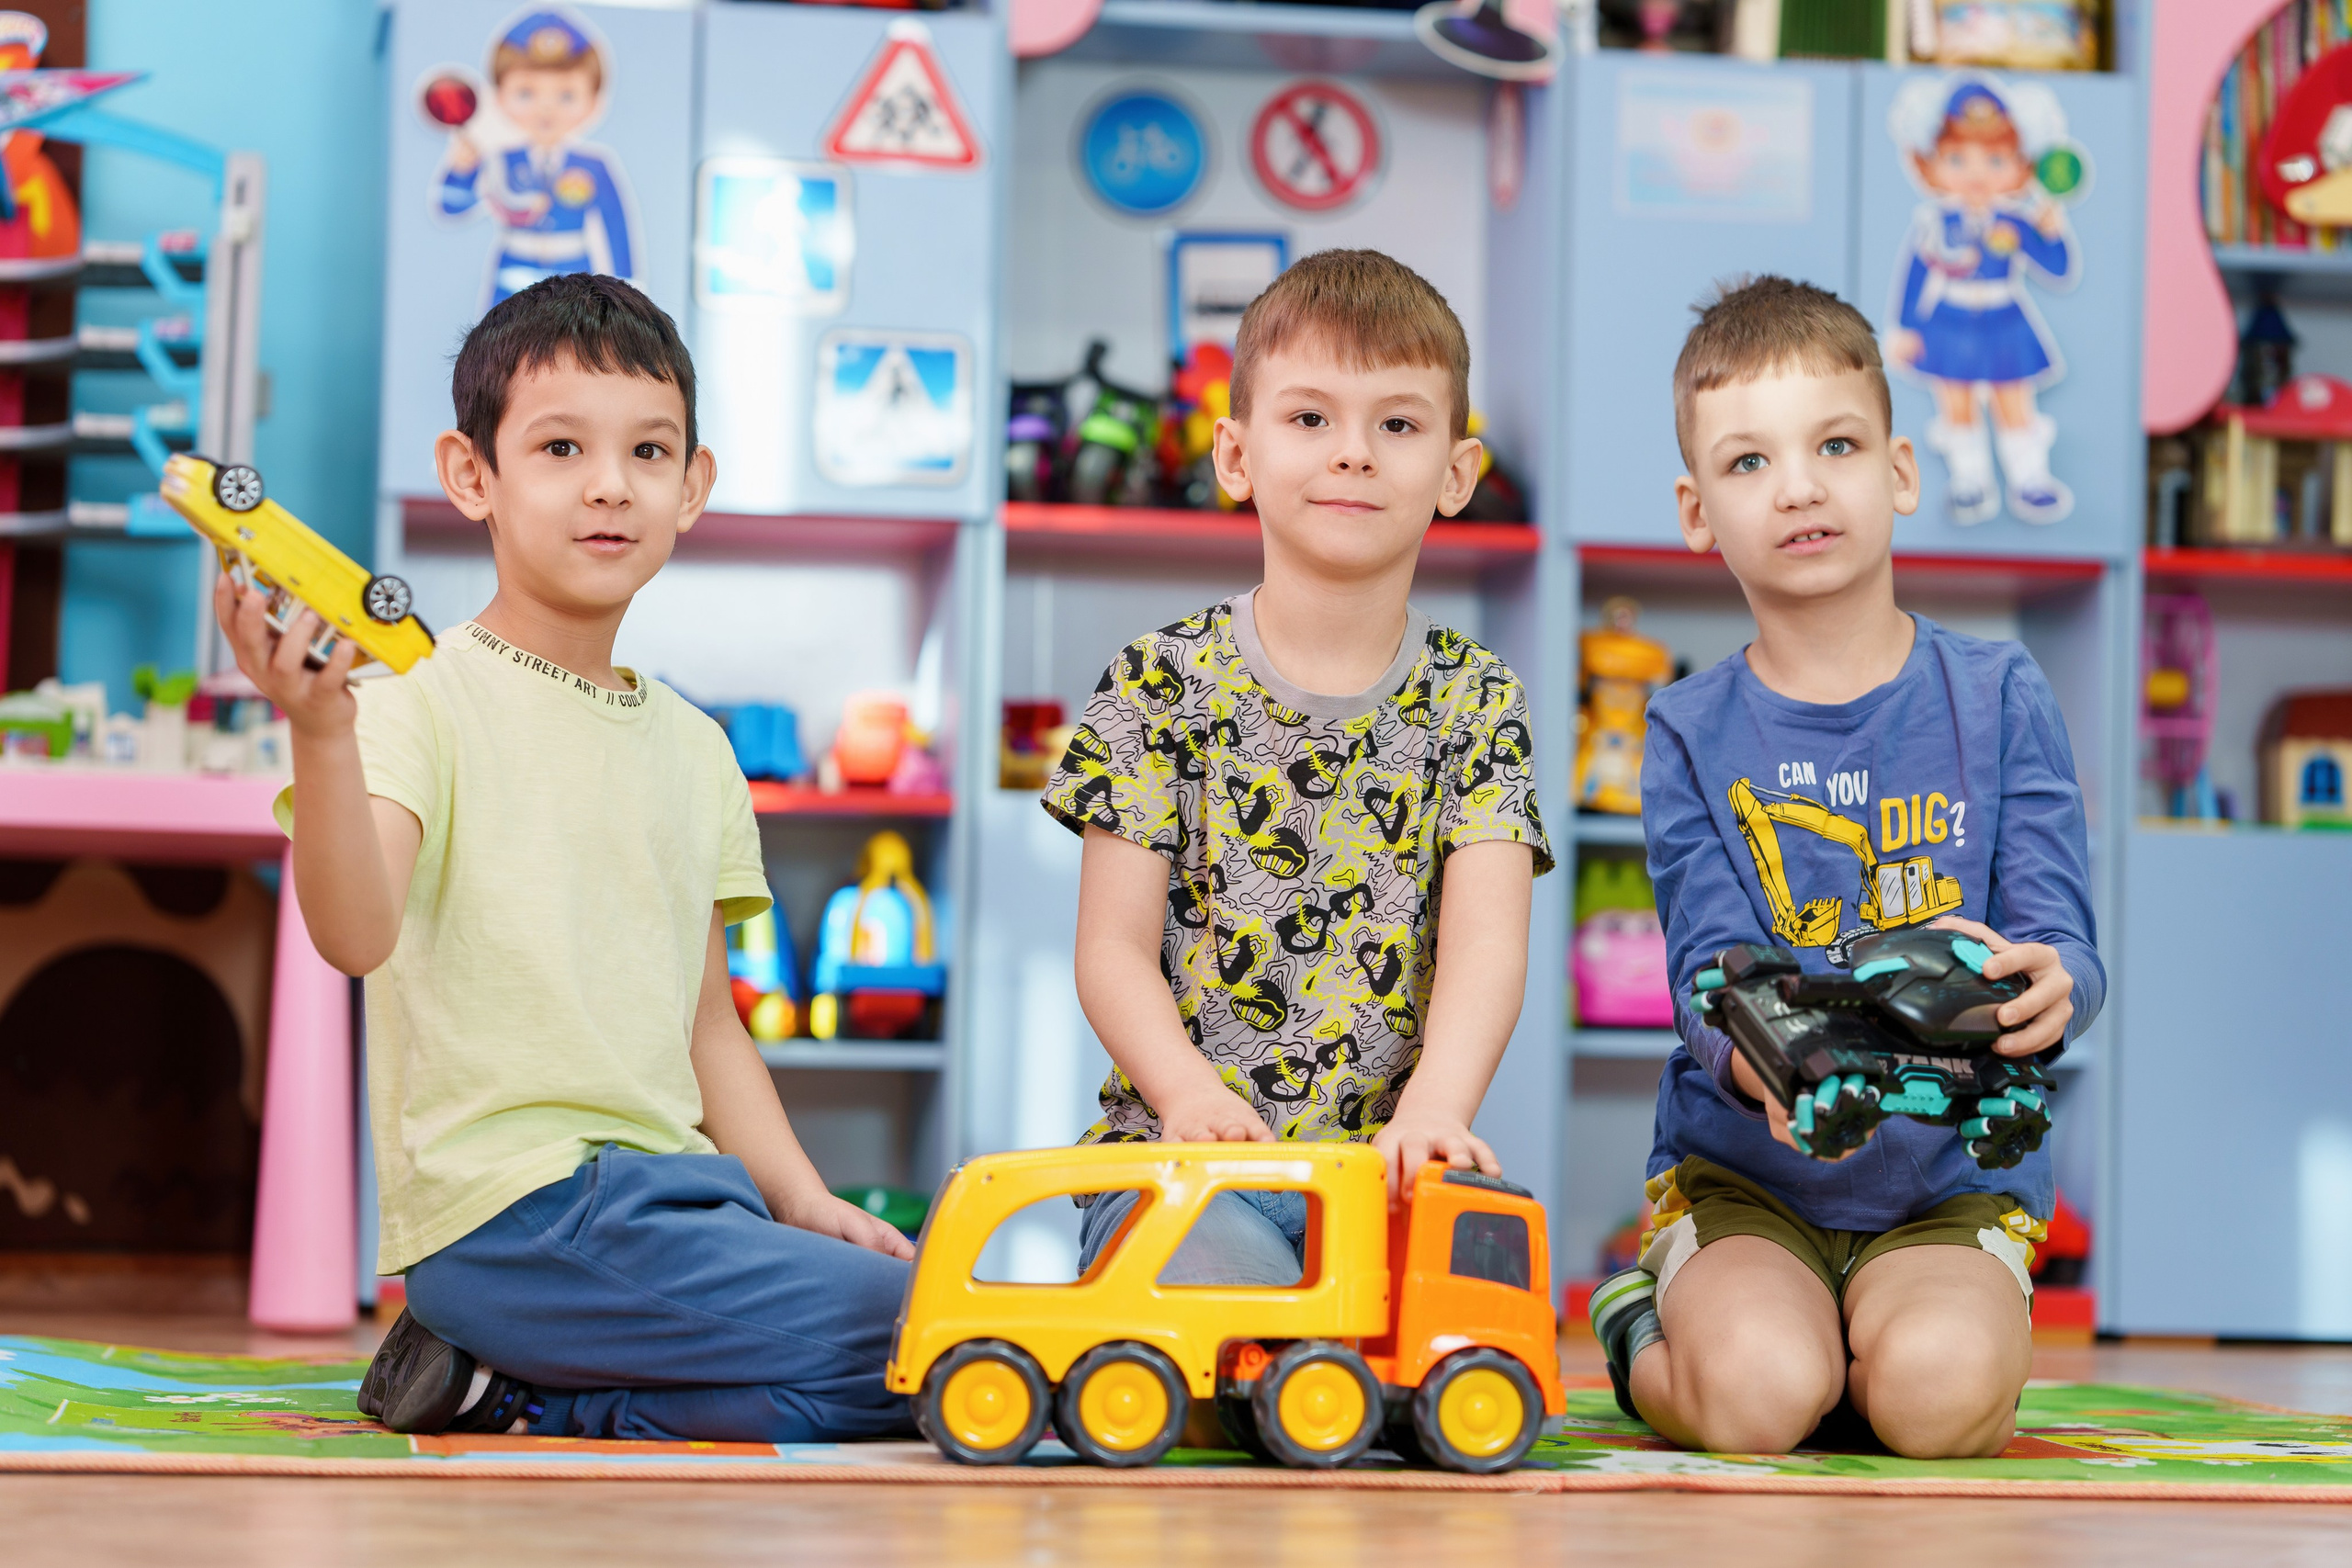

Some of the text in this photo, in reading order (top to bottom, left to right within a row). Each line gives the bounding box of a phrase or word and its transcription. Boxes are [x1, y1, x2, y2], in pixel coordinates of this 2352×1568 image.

[465, 624, 510, 655] FUNNY
[513, 650, 570, 683] STREET
[574, 677, 598, 699] ART
[1778, 761, 1966, 852] CAN YOU DIG?
